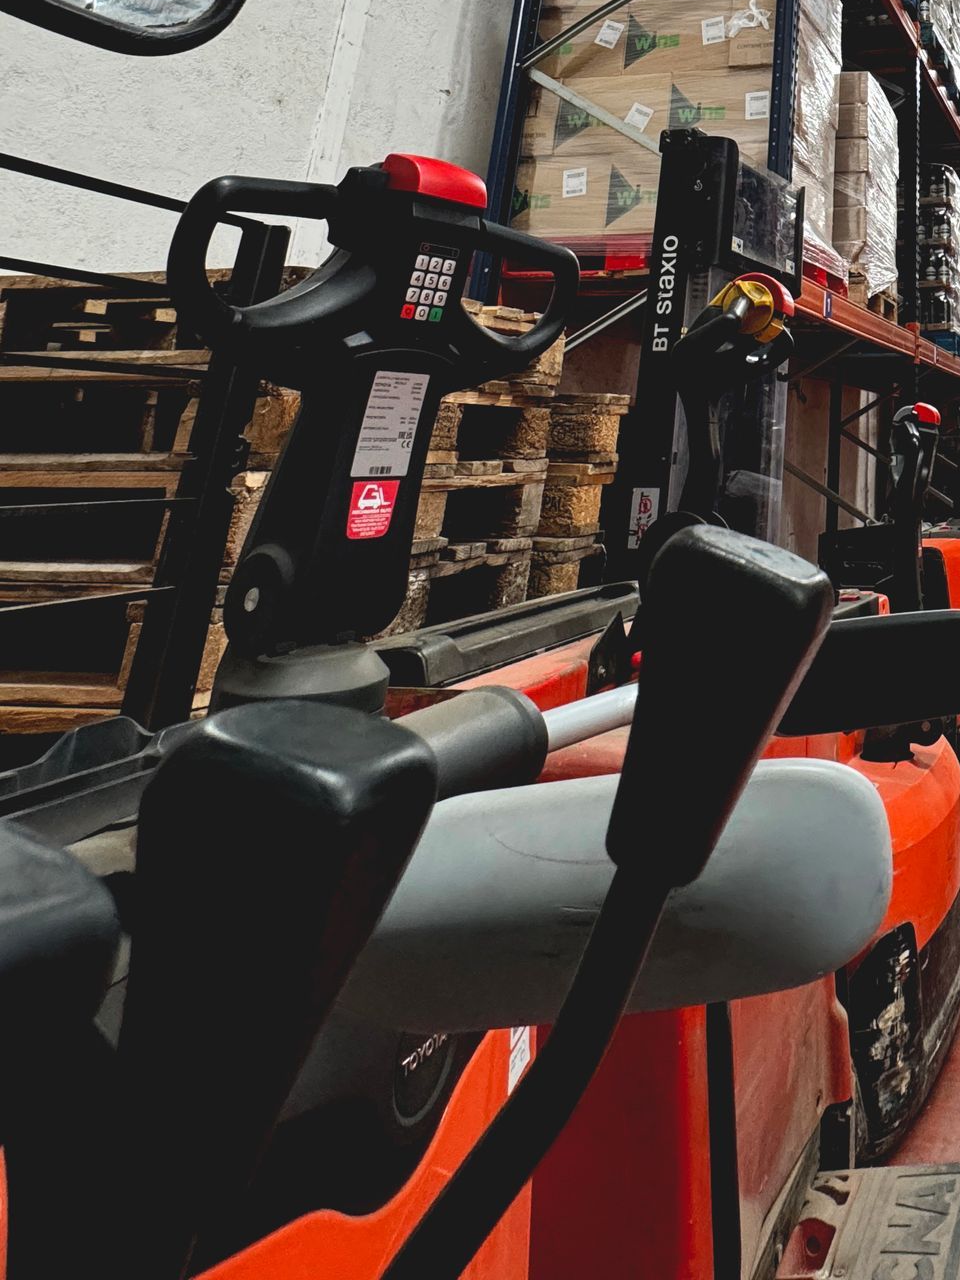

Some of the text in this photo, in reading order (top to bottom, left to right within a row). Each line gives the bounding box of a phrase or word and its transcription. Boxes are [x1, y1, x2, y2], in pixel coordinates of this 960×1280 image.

[420, 258, 453, 271] 1 2 3
[414, 275, 448, 287] 4 5 6
[411, 290, 444, 303] 7 8 9
[652, 235, 679, 352] BT staxio
